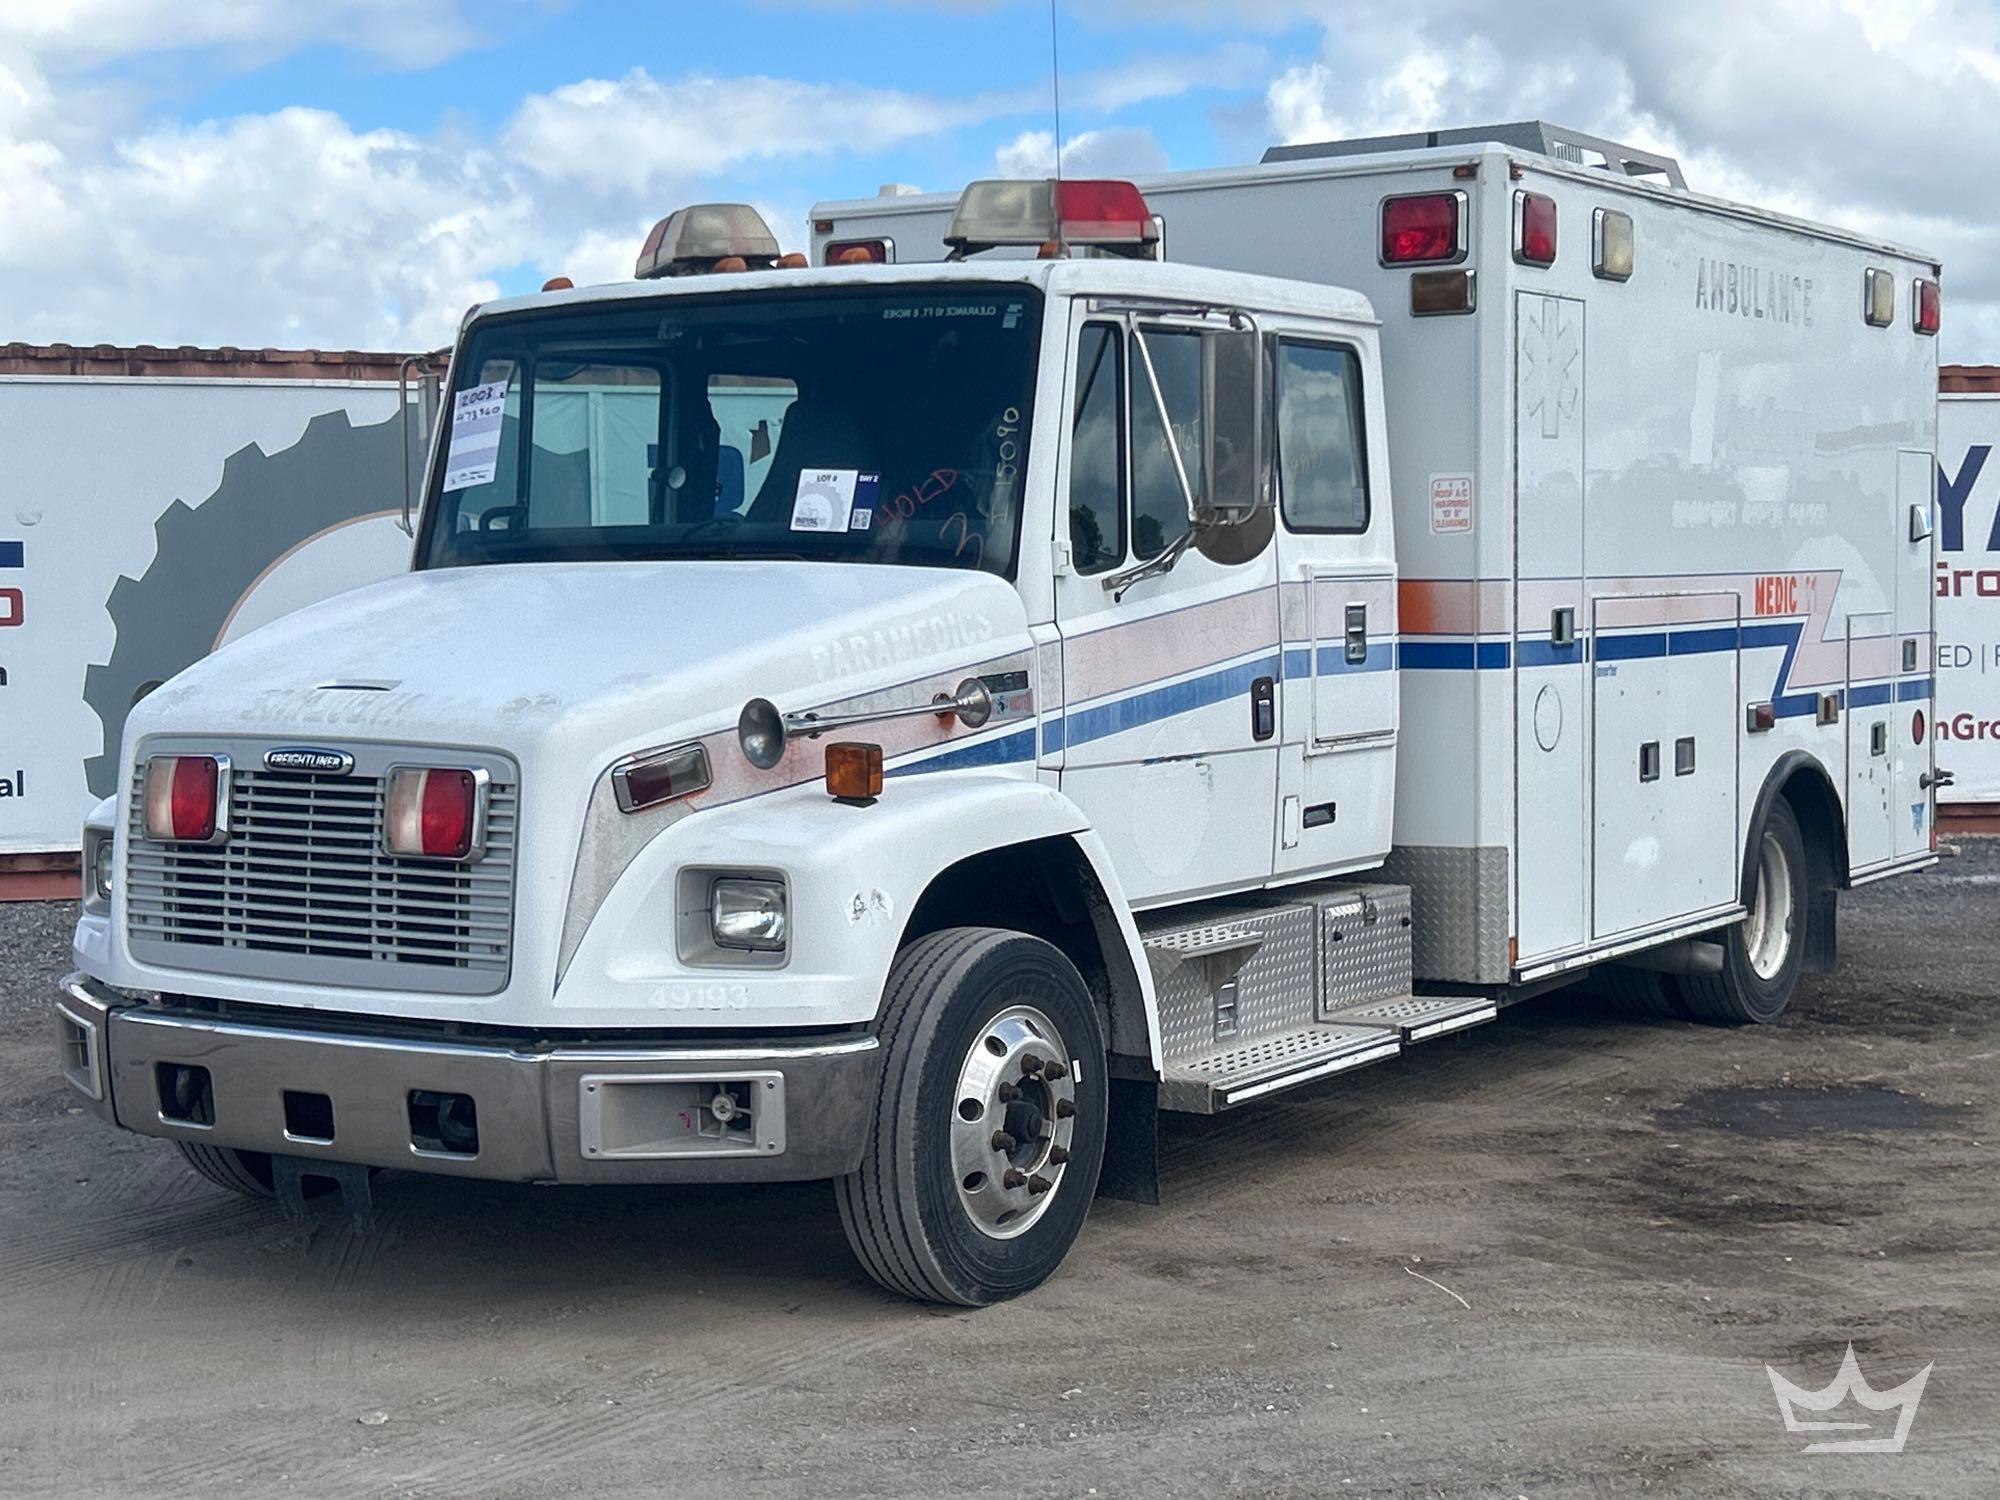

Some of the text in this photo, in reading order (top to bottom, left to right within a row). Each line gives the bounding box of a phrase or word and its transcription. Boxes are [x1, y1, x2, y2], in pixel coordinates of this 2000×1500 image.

[1696, 257, 1813, 326] AMBULANCE
[874, 468, 958, 527] HOLD
[1755, 575, 1797, 615] MEDIC
[270, 753, 340, 768] FREIGHTLINER
